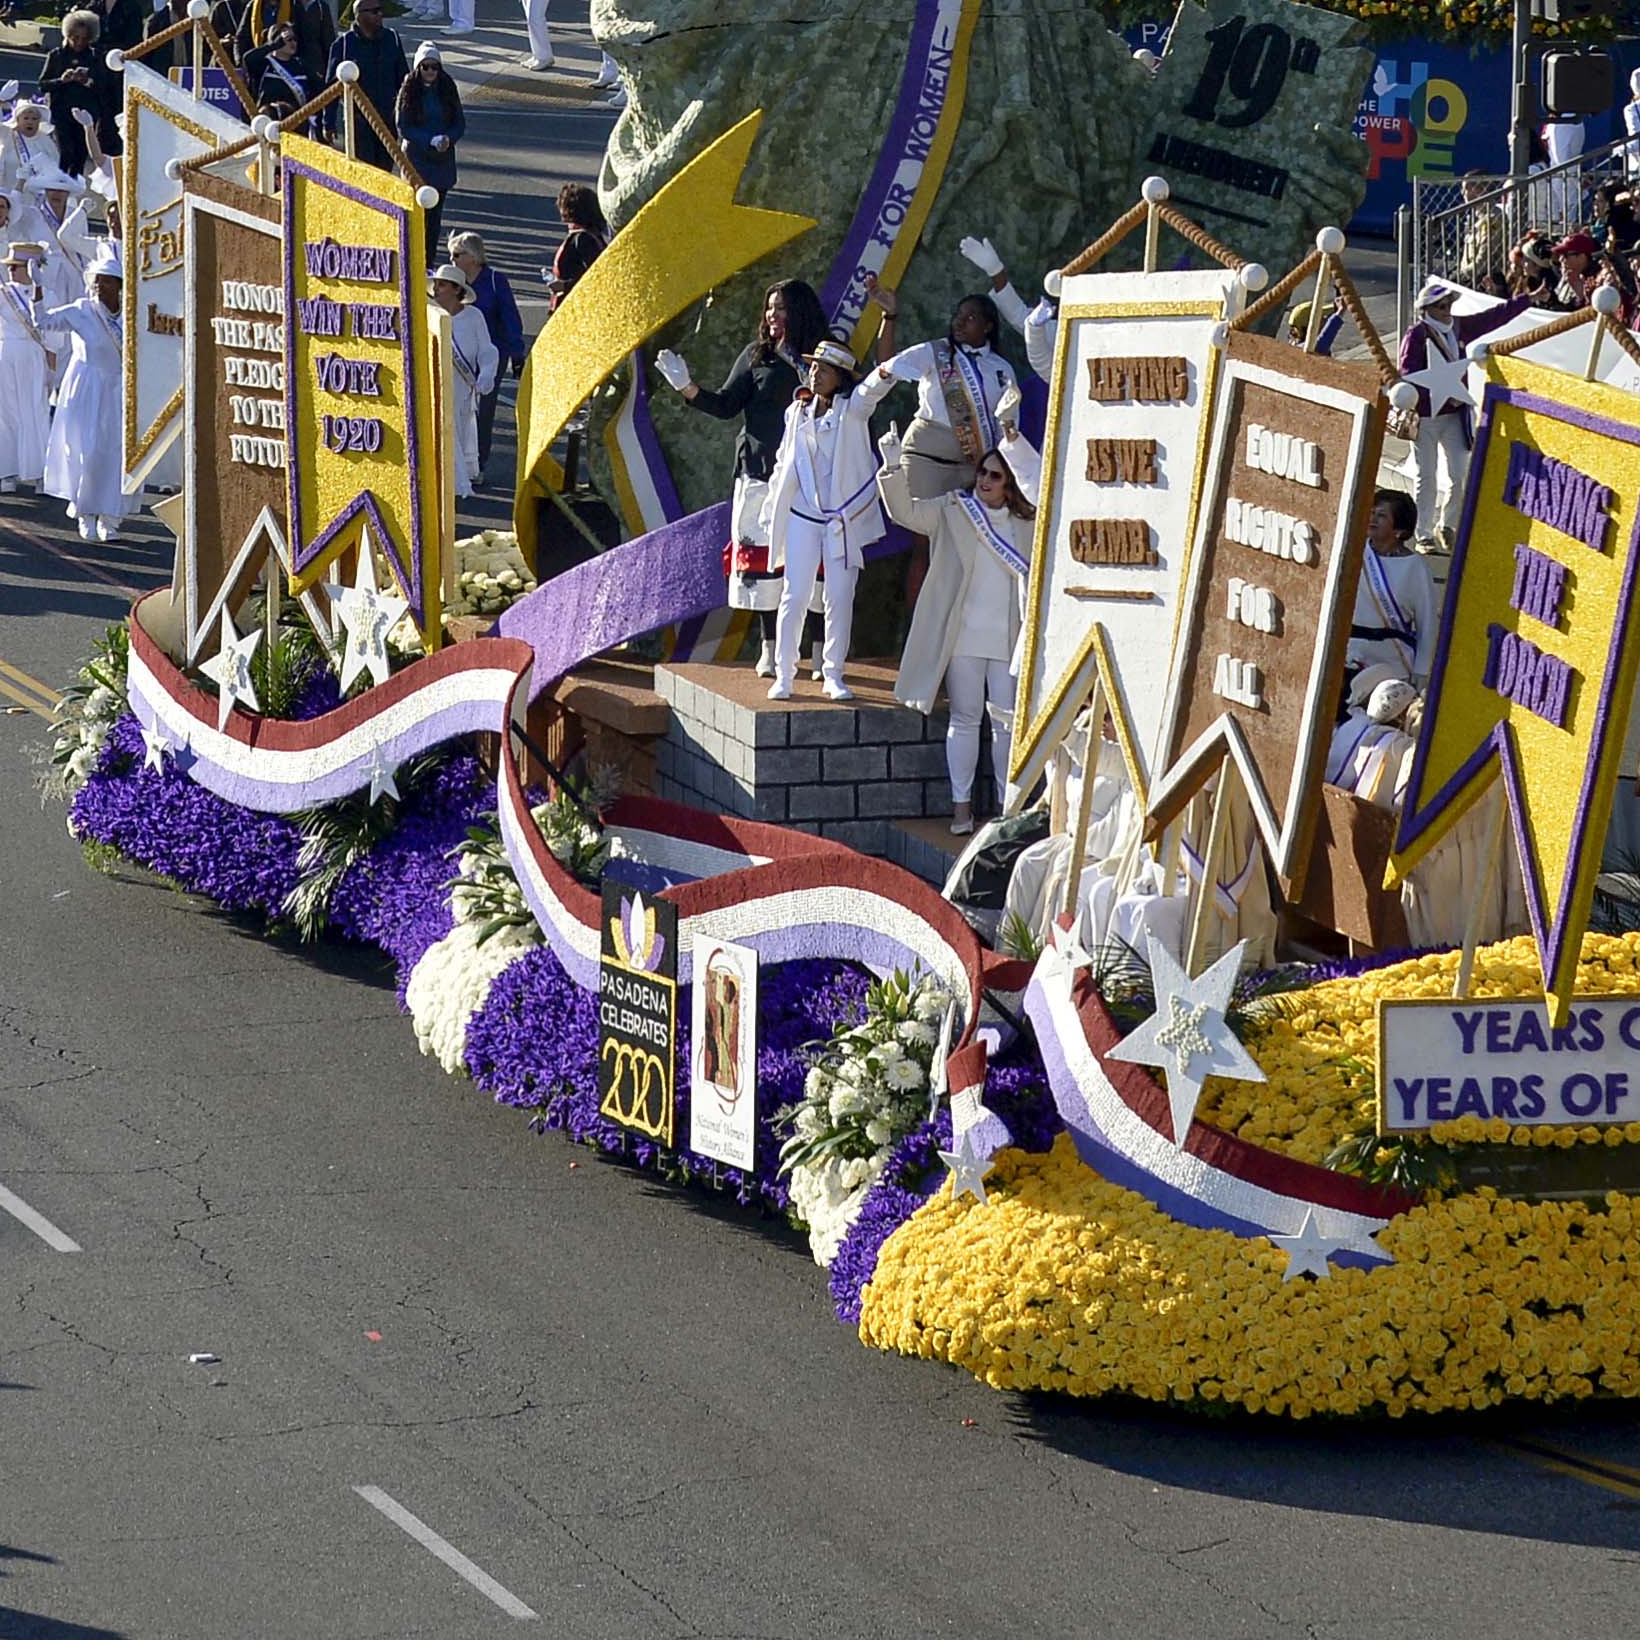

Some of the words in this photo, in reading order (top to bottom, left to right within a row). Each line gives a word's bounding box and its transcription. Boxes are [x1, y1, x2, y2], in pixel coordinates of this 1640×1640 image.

[1357, 99, 1377, 112] HE
[869, 181, 918, 250] FOR
[303, 236, 393, 283] WOMEN
[297, 293, 342, 336] WIN
[348, 302, 396, 340] THE
[829, 264, 878, 343] OTES
[211, 317, 253, 347] THE
[252, 322, 285, 353] PAS
[223, 356, 285, 391] PLEDG
[315, 351, 379, 396] VOTE
[1086, 356, 1189, 402] LIFTING
[229, 396, 258, 425] TO
[258, 399, 285, 430] TH
[322, 414, 380, 453] 1920
[229, 433, 285, 468] FUTU
[1085, 439, 1118, 484] AS
[1114, 439, 1158, 484] WE
[1245, 423, 1322, 488] EQUAL
[1501, 439, 1613, 552] PASSING
[1069, 517, 1159, 566] CLIMB.
[1224, 496, 1314, 565] RIGHTS
[1227, 576, 1277, 634] FOR
[1509, 543, 1568, 630] THE
[1212, 652, 1260, 709] ALL
[1481, 622, 1574, 729] TORCH
[600, 970, 669, 1017] PASADENA
[600, 1001, 668, 1048] CELEBRATES
[1451, 1007, 1604, 1055] YEARS
[600, 1036, 667, 1137] 2020
[1393, 1073, 1546, 1120] YEARS
[1559, 1072, 1629, 1116] OF
